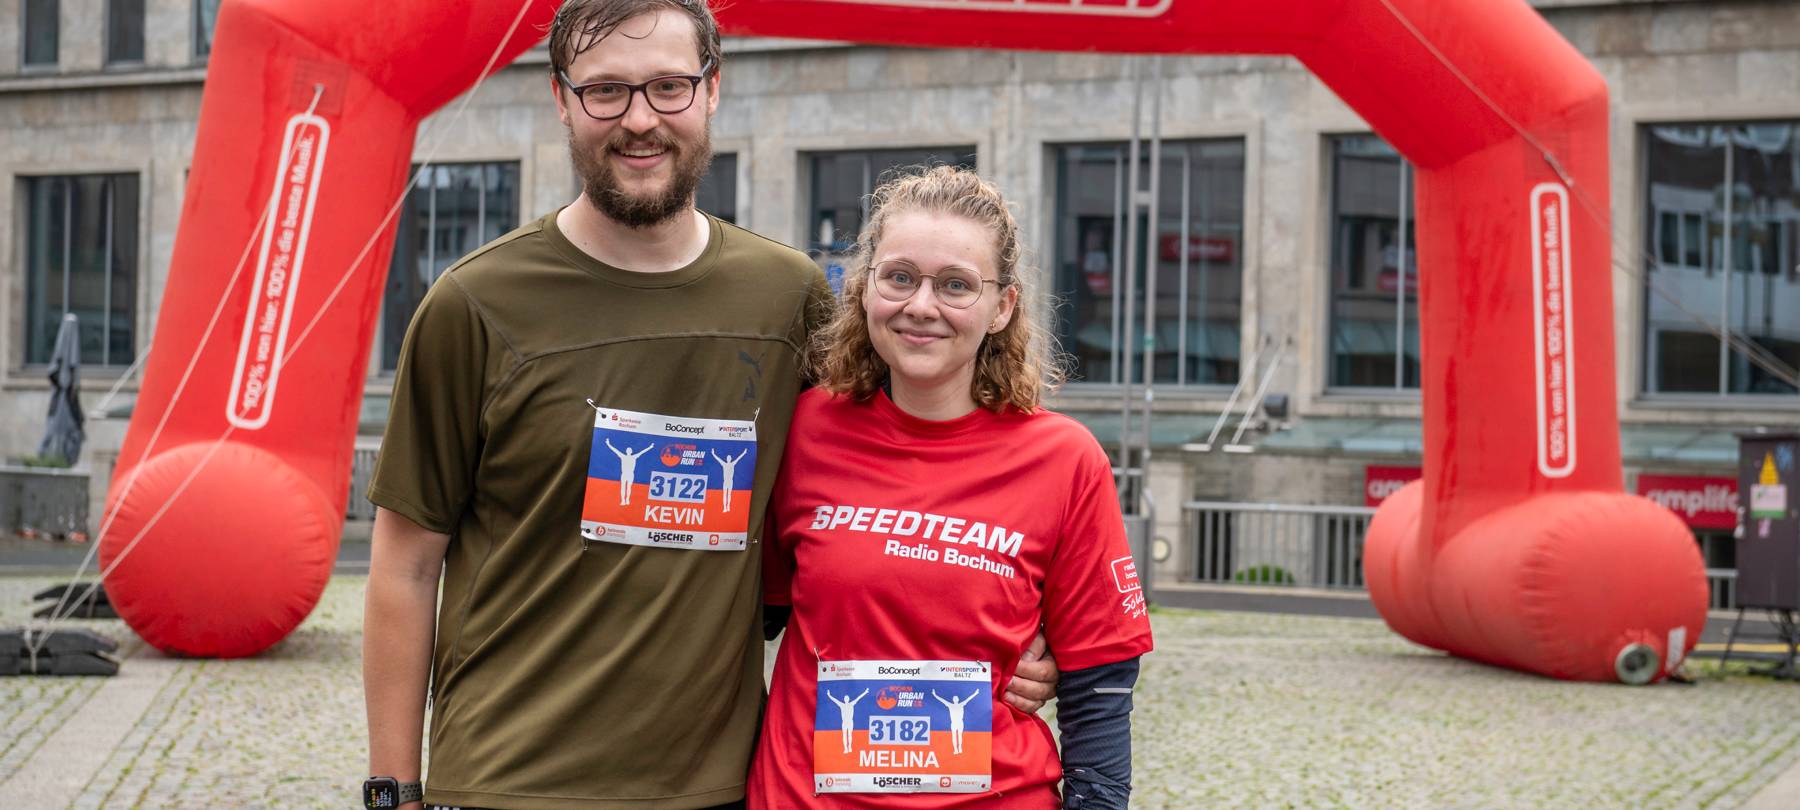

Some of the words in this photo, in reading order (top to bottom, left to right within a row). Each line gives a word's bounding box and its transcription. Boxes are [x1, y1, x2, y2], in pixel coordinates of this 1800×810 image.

[277, 229, 295, 253] die
[267, 253, 290, 299] 100%
[257, 334, 272, 361] von
[664, 423, 705, 436] BoConcept
[680, 458, 695, 466] RUN
[682, 450, 706, 459] URBAN
[650, 475, 706, 500] 3122
[644, 504, 705, 526] KEVIN
[648, 531, 694, 543] LÖSCHER
[808, 505, 1025, 558] SPEEDTEAM
[884, 539, 939, 562] Radio
[943, 547, 1015, 579] Bochum
[878, 666, 921, 677] BoConcept
[897, 699, 914, 707] RUN
[898, 691, 925, 700] URBAN
[870, 719, 929, 742] 3182
[859, 749, 940, 768] MELINA
[872, 776, 922, 788] LÖSCHER
